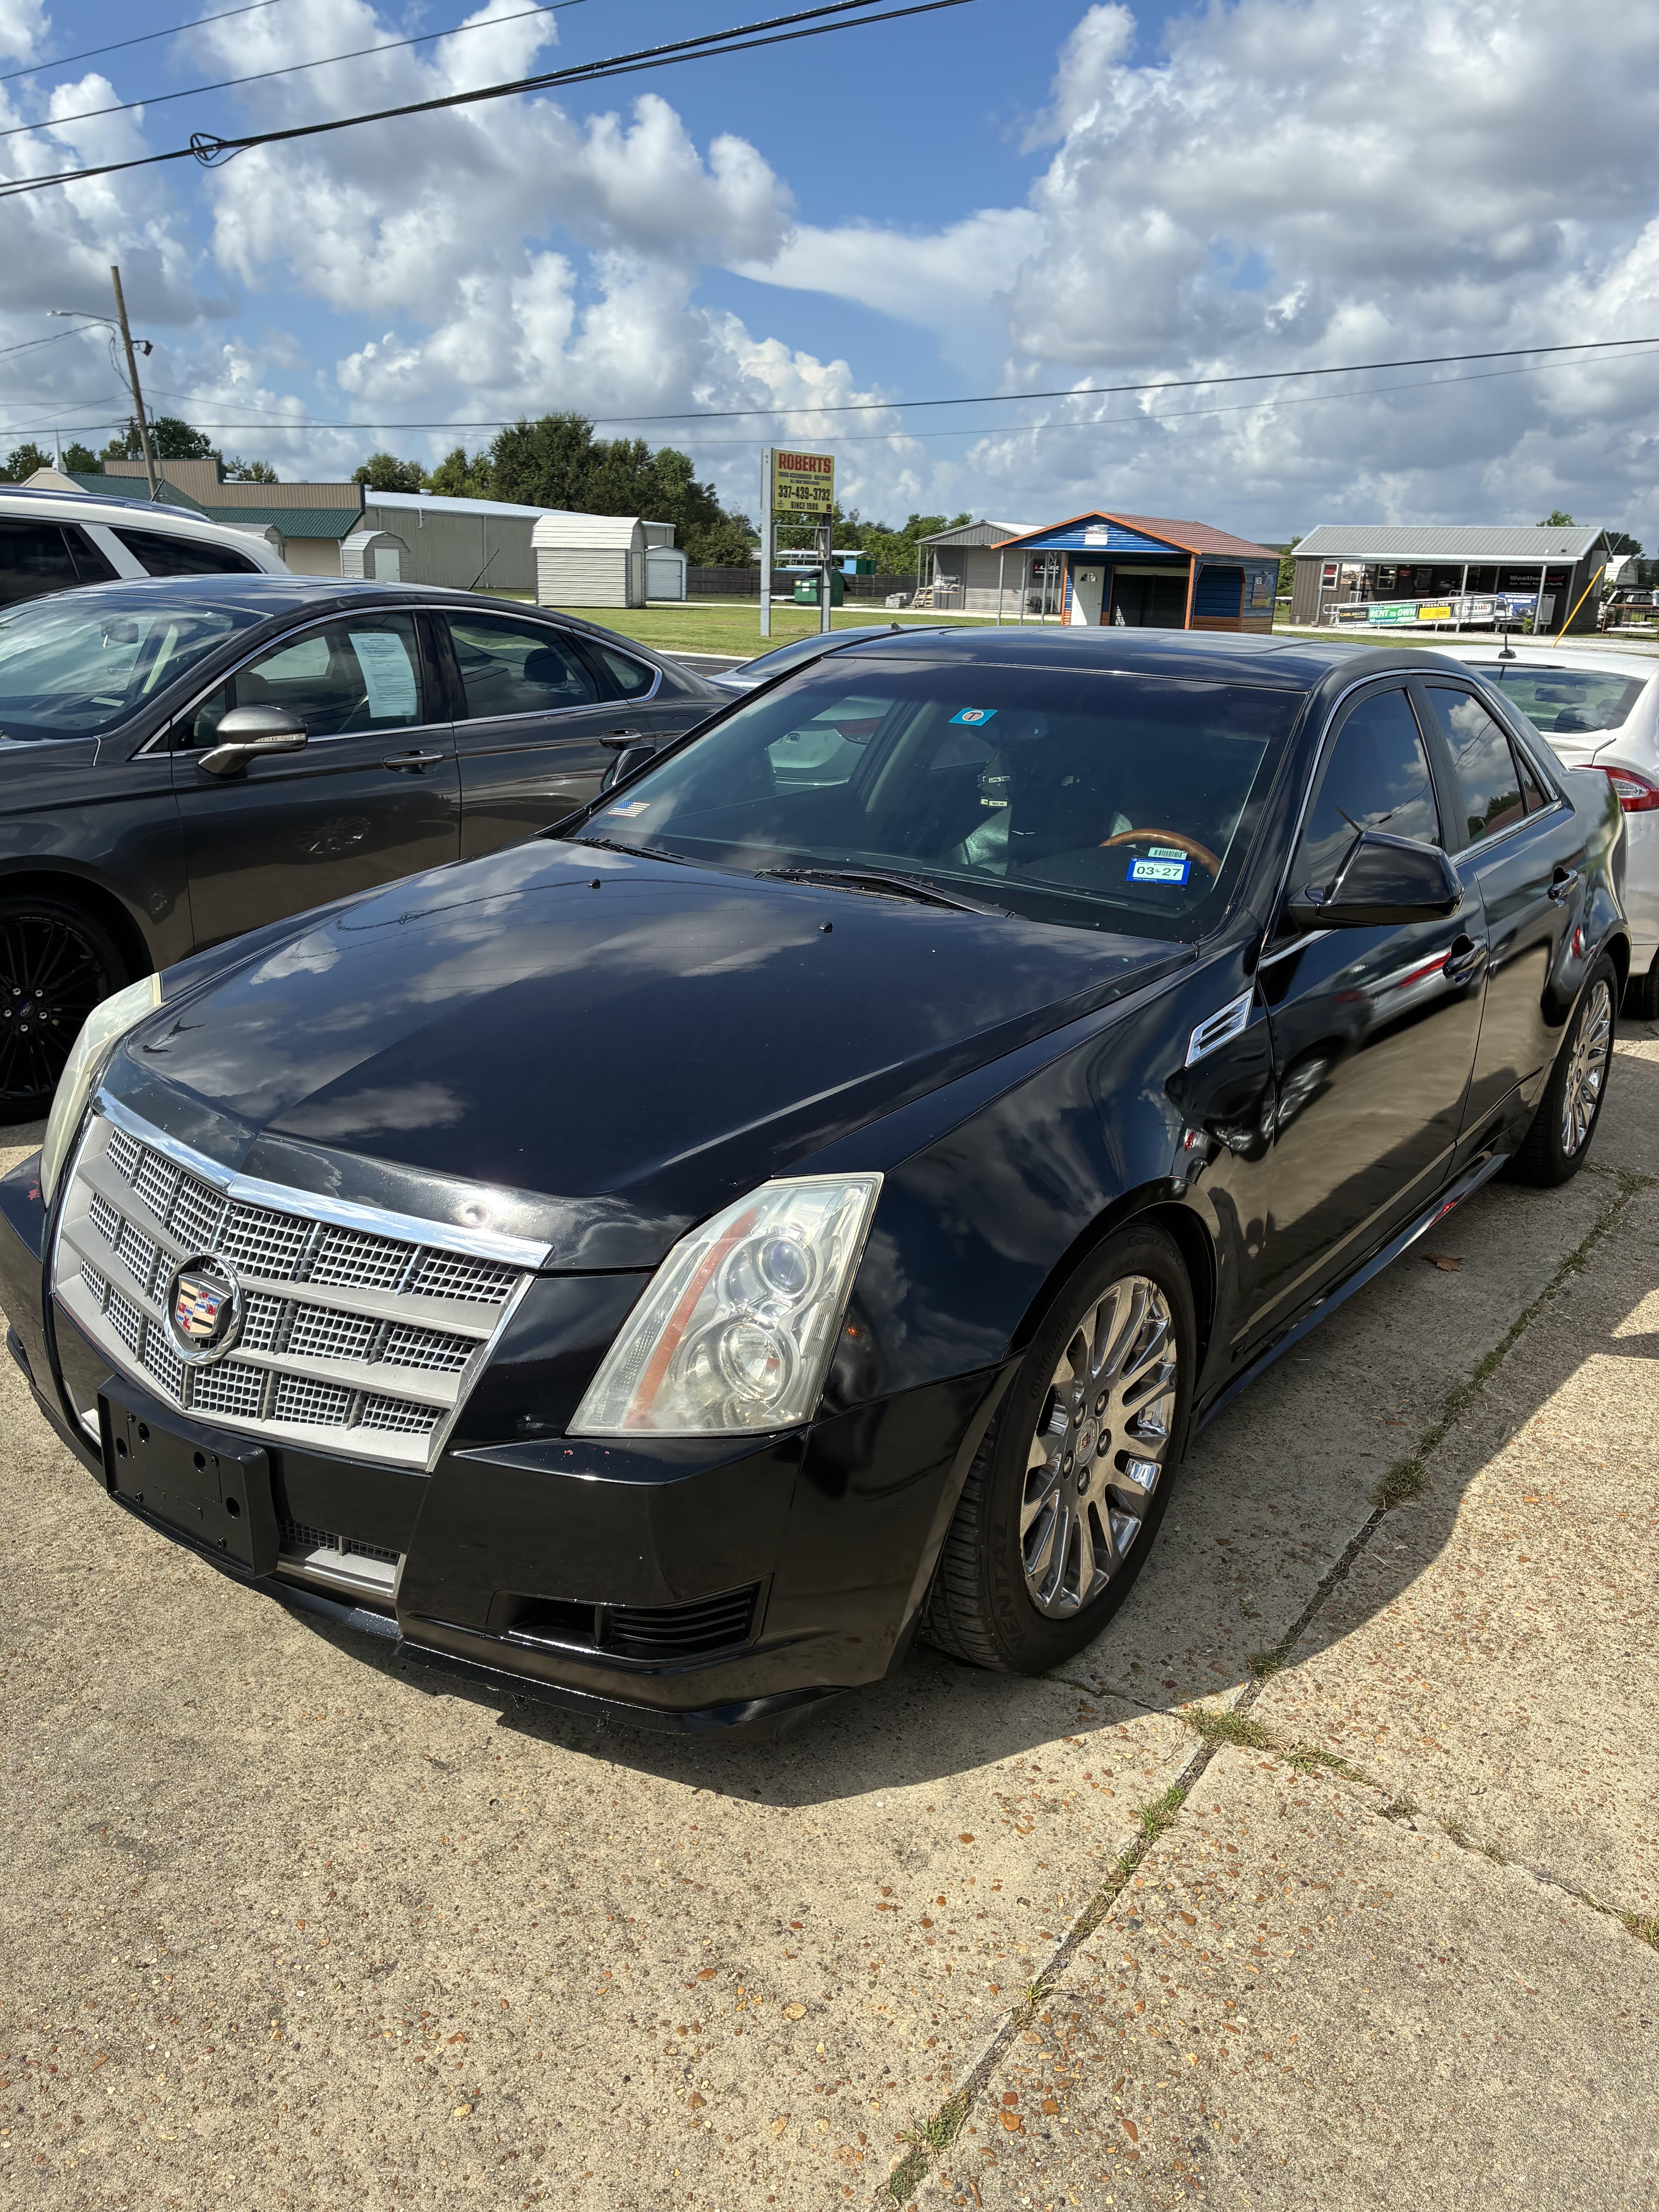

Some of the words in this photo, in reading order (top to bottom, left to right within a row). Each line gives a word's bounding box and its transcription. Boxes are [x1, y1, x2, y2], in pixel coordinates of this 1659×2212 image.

[779, 453, 831, 473] ROBERTS
[778, 485, 830, 501] 337-439-3732
[790, 501, 805, 510] SINCE
[1370, 609, 1390, 618] RENT
[1397, 608, 1416, 617] OWN
